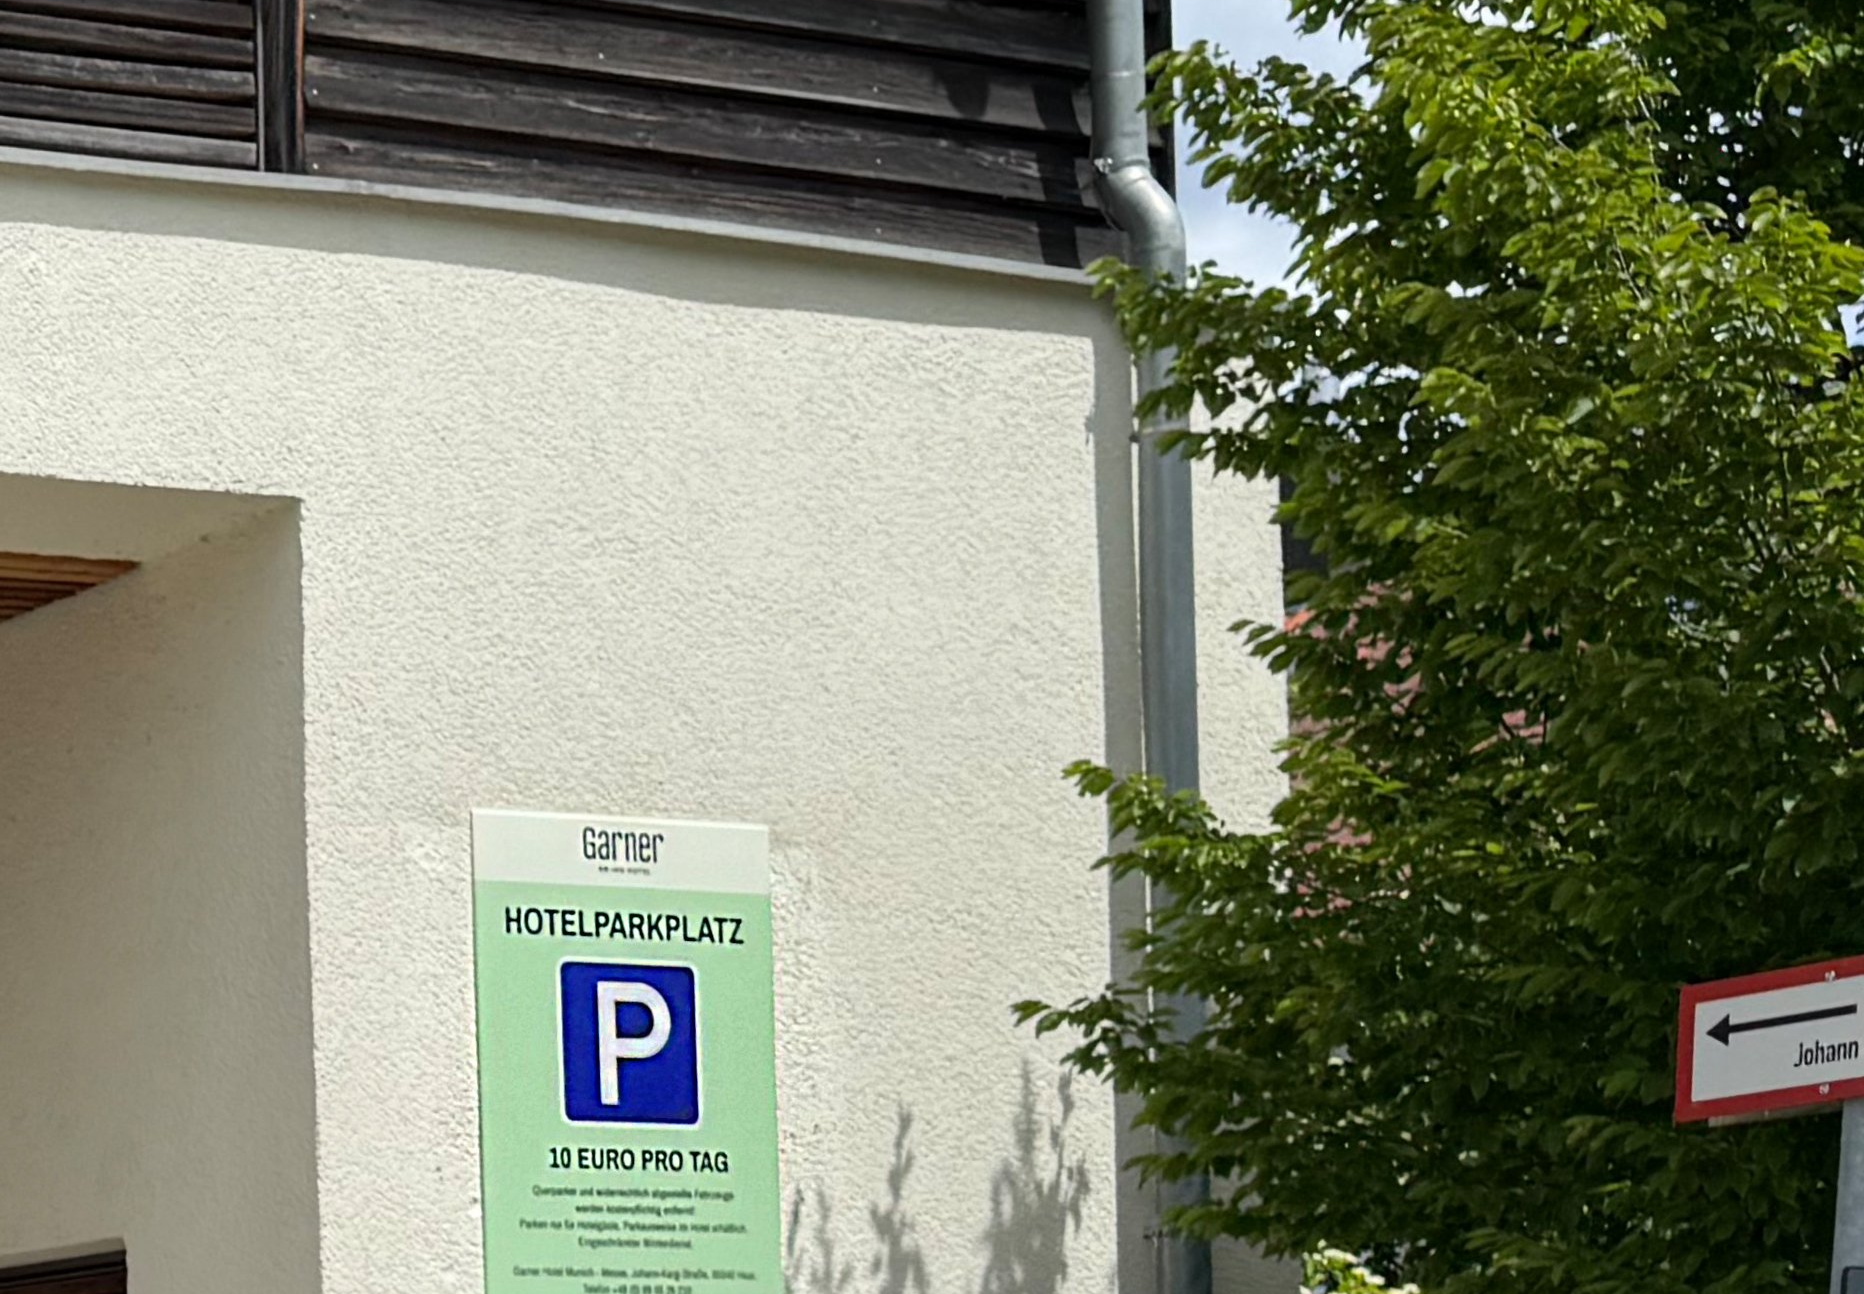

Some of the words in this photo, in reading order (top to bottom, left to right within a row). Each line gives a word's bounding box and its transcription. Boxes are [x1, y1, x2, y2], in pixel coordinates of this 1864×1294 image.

[582, 826, 664, 864] Garner
[505, 906, 745, 945] HOTELPARKPLATZ
[596, 980, 672, 1106] P
[1793, 1039, 1859, 1067] Johann
[549, 1147, 571, 1169] 10
[577, 1148, 636, 1171] EURO
[641, 1149, 684, 1172] PRO
[689, 1151, 729, 1173] TAG
